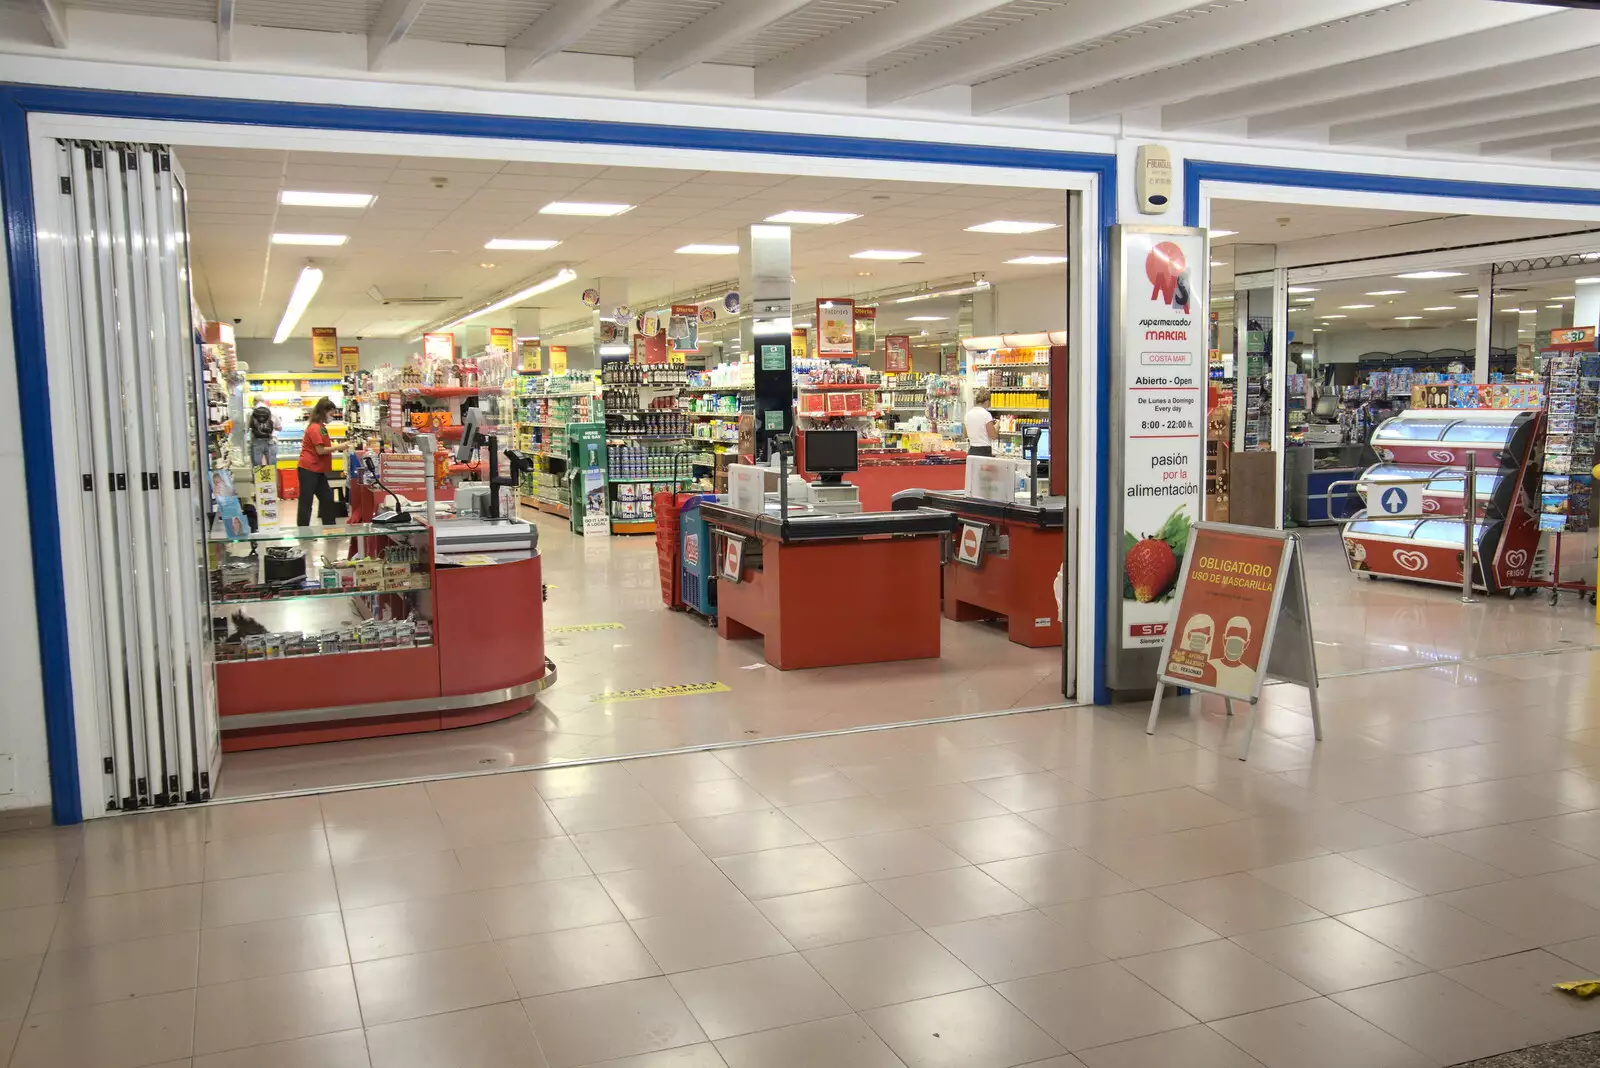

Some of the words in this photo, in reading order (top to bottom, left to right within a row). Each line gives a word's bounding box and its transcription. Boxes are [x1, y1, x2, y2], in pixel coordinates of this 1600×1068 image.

[1139, 318, 1192, 328] supermercados
[1145, 331, 1187, 341] MARCIAL
[1570, 331, 1585, 342] 3D
[1149, 355, 1171, 363] COSTA
[1173, 355, 1187, 363] MAR
[1135, 376, 1167, 385] Abierto
[1174, 376, 1193, 387] Open
[1172, 397, 1194, 405] Domingo
[1154, 405, 1171, 413] Every
[1172, 405, 1182, 413] day
[1141, 420, 1160, 429] 8:00
[1167, 420, 1187, 429] 22:00
[1151, 453, 1188, 469] pasión
[1163, 471, 1178, 482] por
[1180, 469, 1187, 479] la
[1127, 482, 1198, 497] alimentación
[1199, 556, 1272, 578] OBLIGATORIO
[1506, 569, 1525, 578] FRIGO
[1191, 571, 1209, 581] USO
[1209, 573, 1221, 584] DE
[1221, 575, 1273, 592] MASCARILLA
